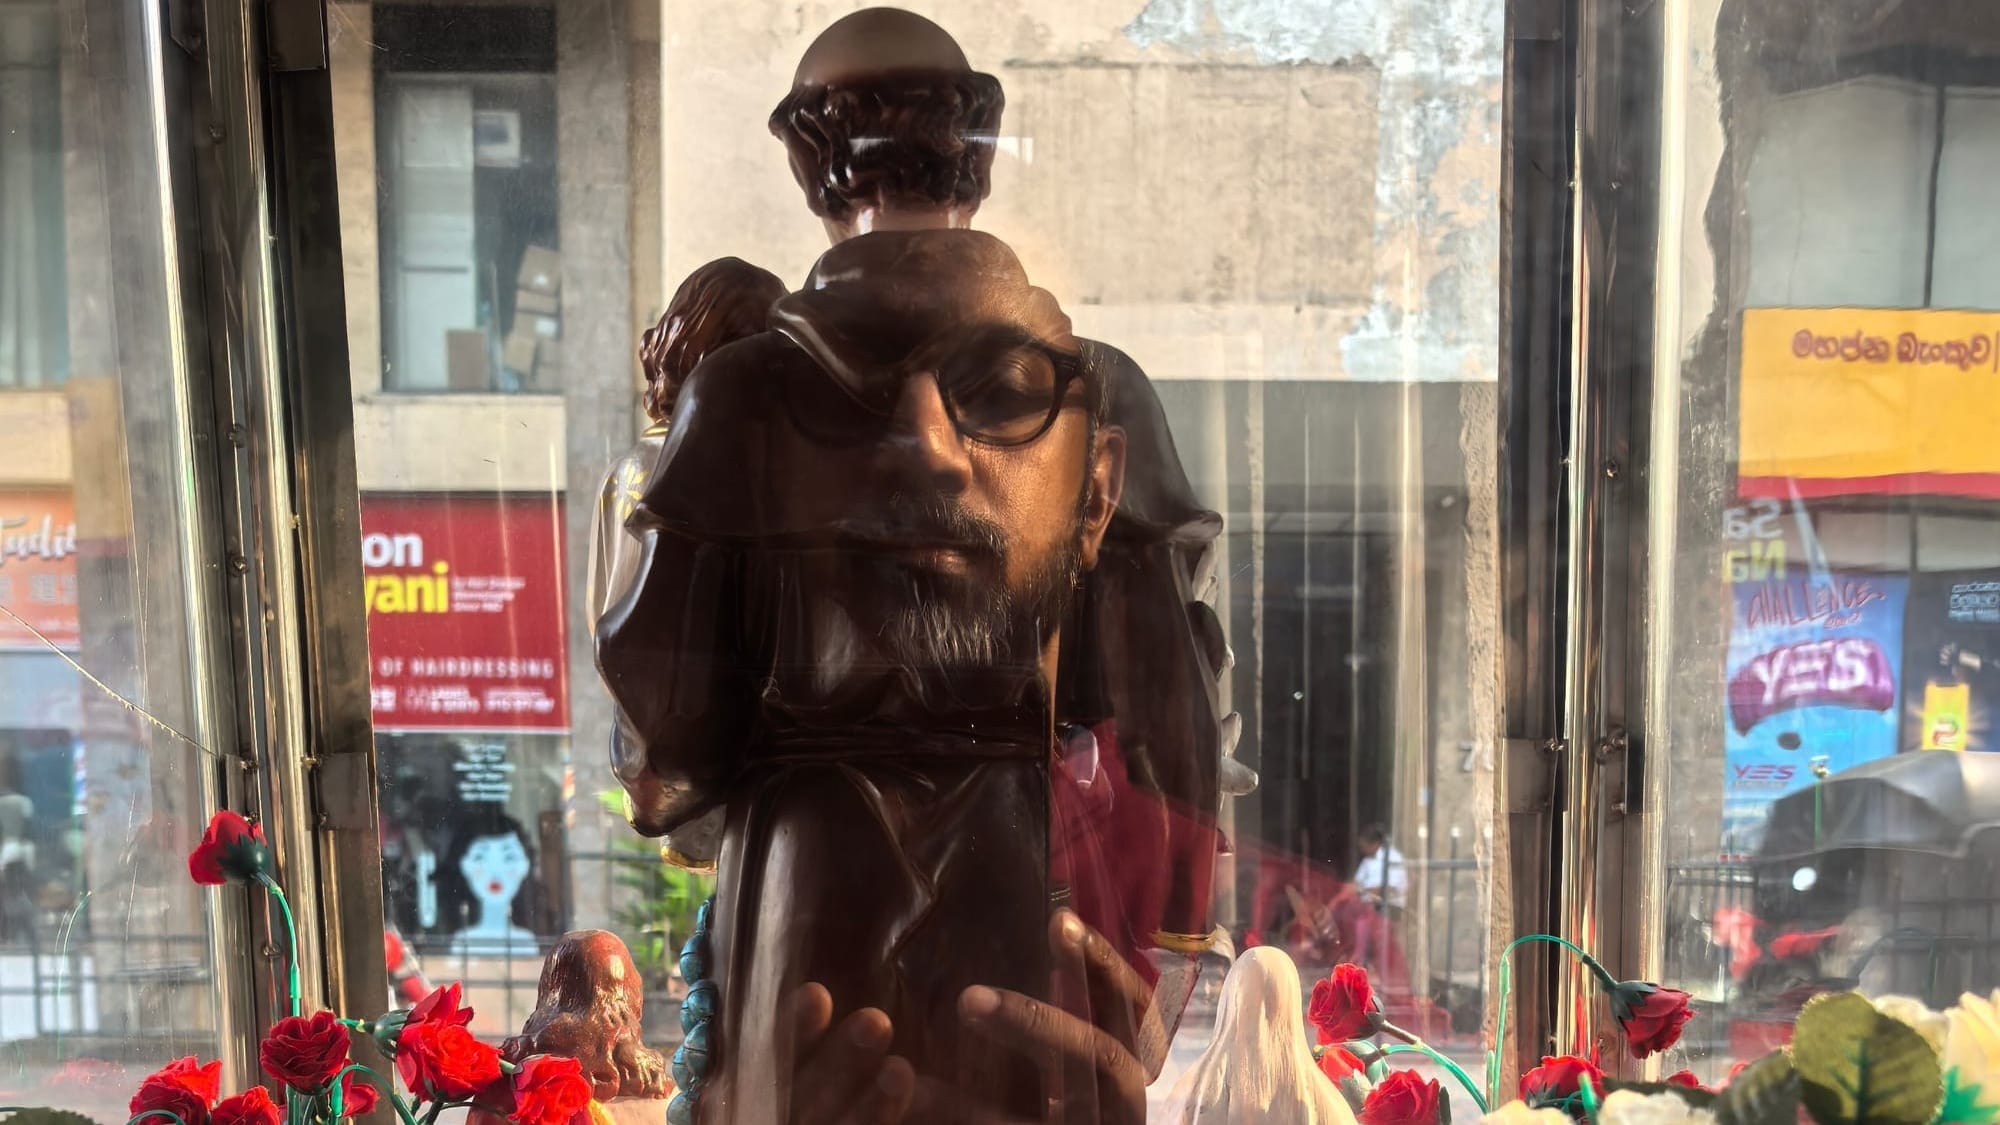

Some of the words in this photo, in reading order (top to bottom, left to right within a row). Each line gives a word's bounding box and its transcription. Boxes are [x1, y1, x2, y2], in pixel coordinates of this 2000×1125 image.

[362, 532, 424, 567] on
[378, 656, 404, 678] OF
[410, 656, 555, 679] HAIRDRESSING
[1752, 638, 1872, 705] YES
[1733, 764, 1797, 780] YES
